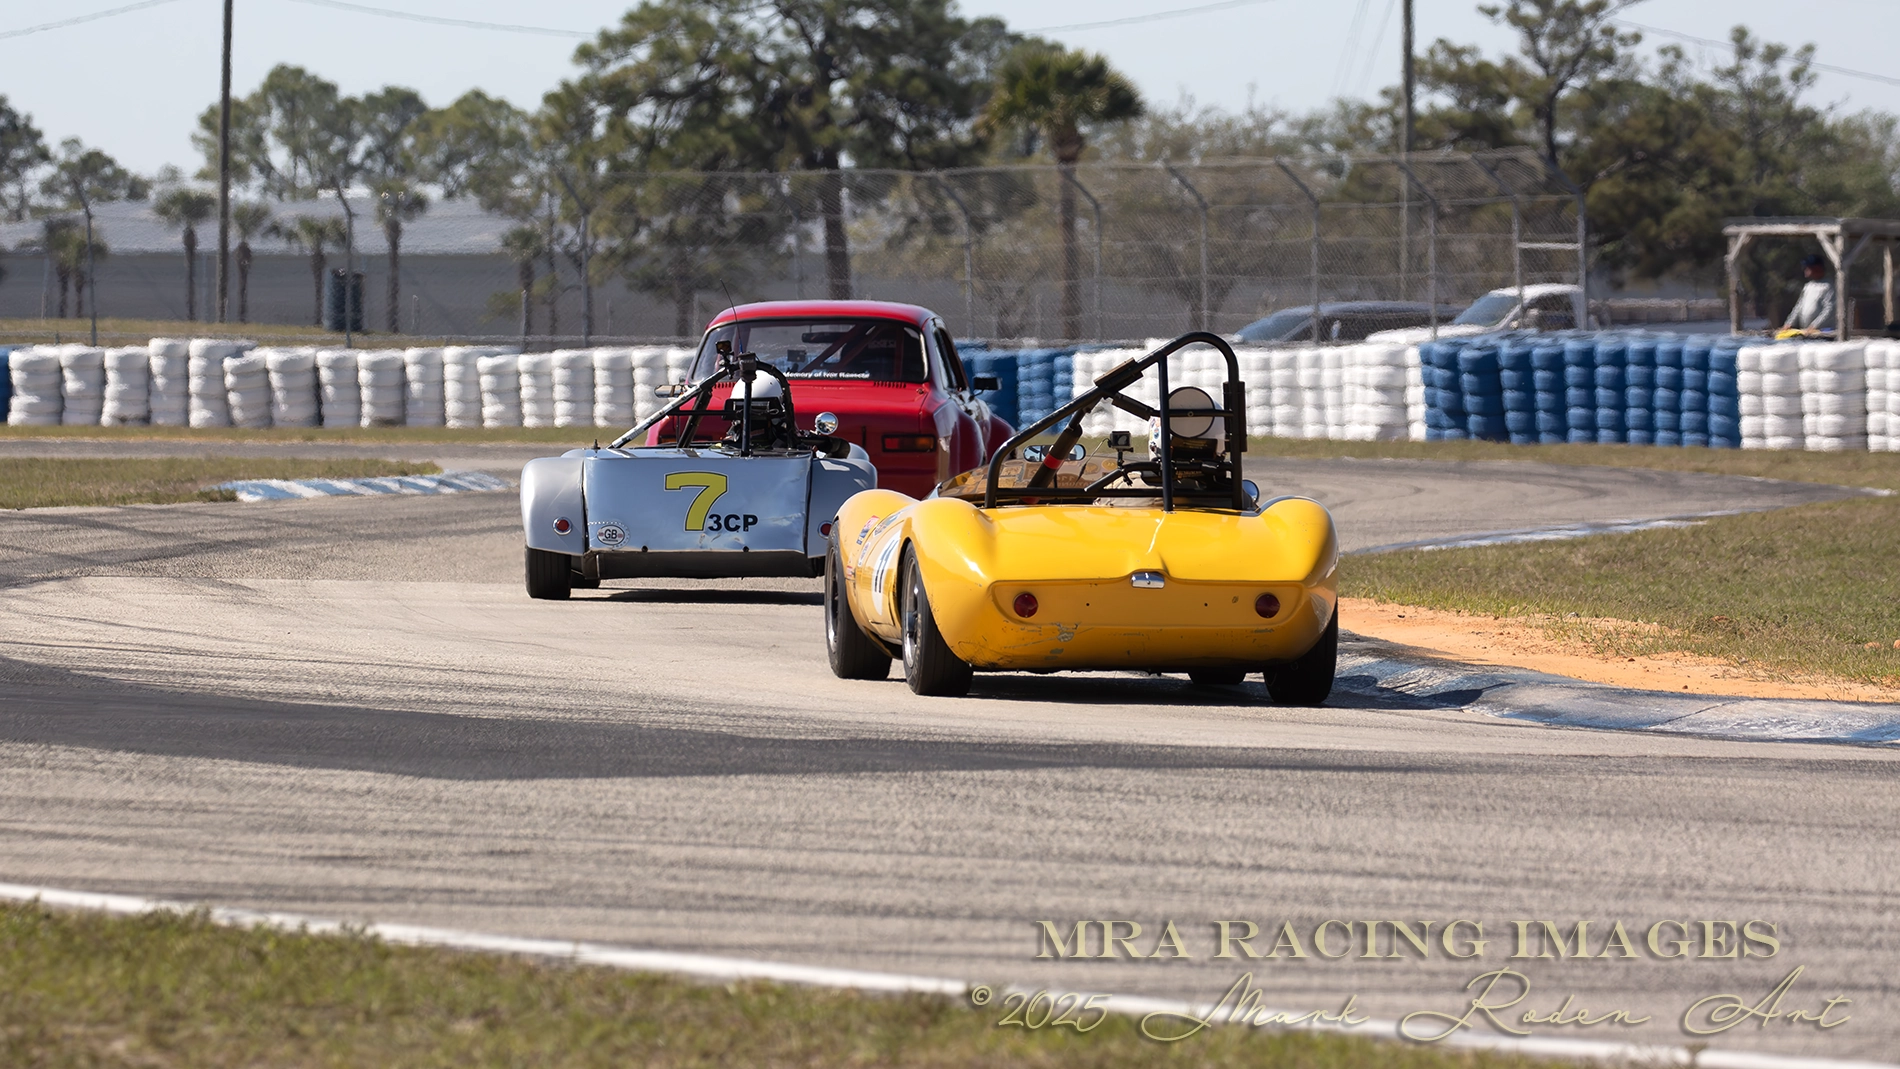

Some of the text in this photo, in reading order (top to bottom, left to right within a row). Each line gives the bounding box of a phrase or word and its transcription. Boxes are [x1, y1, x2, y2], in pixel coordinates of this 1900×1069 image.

[664, 470, 728, 531] 7
[708, 513, 758, 532] 3CP
[604, 528, 618, 539] GB
